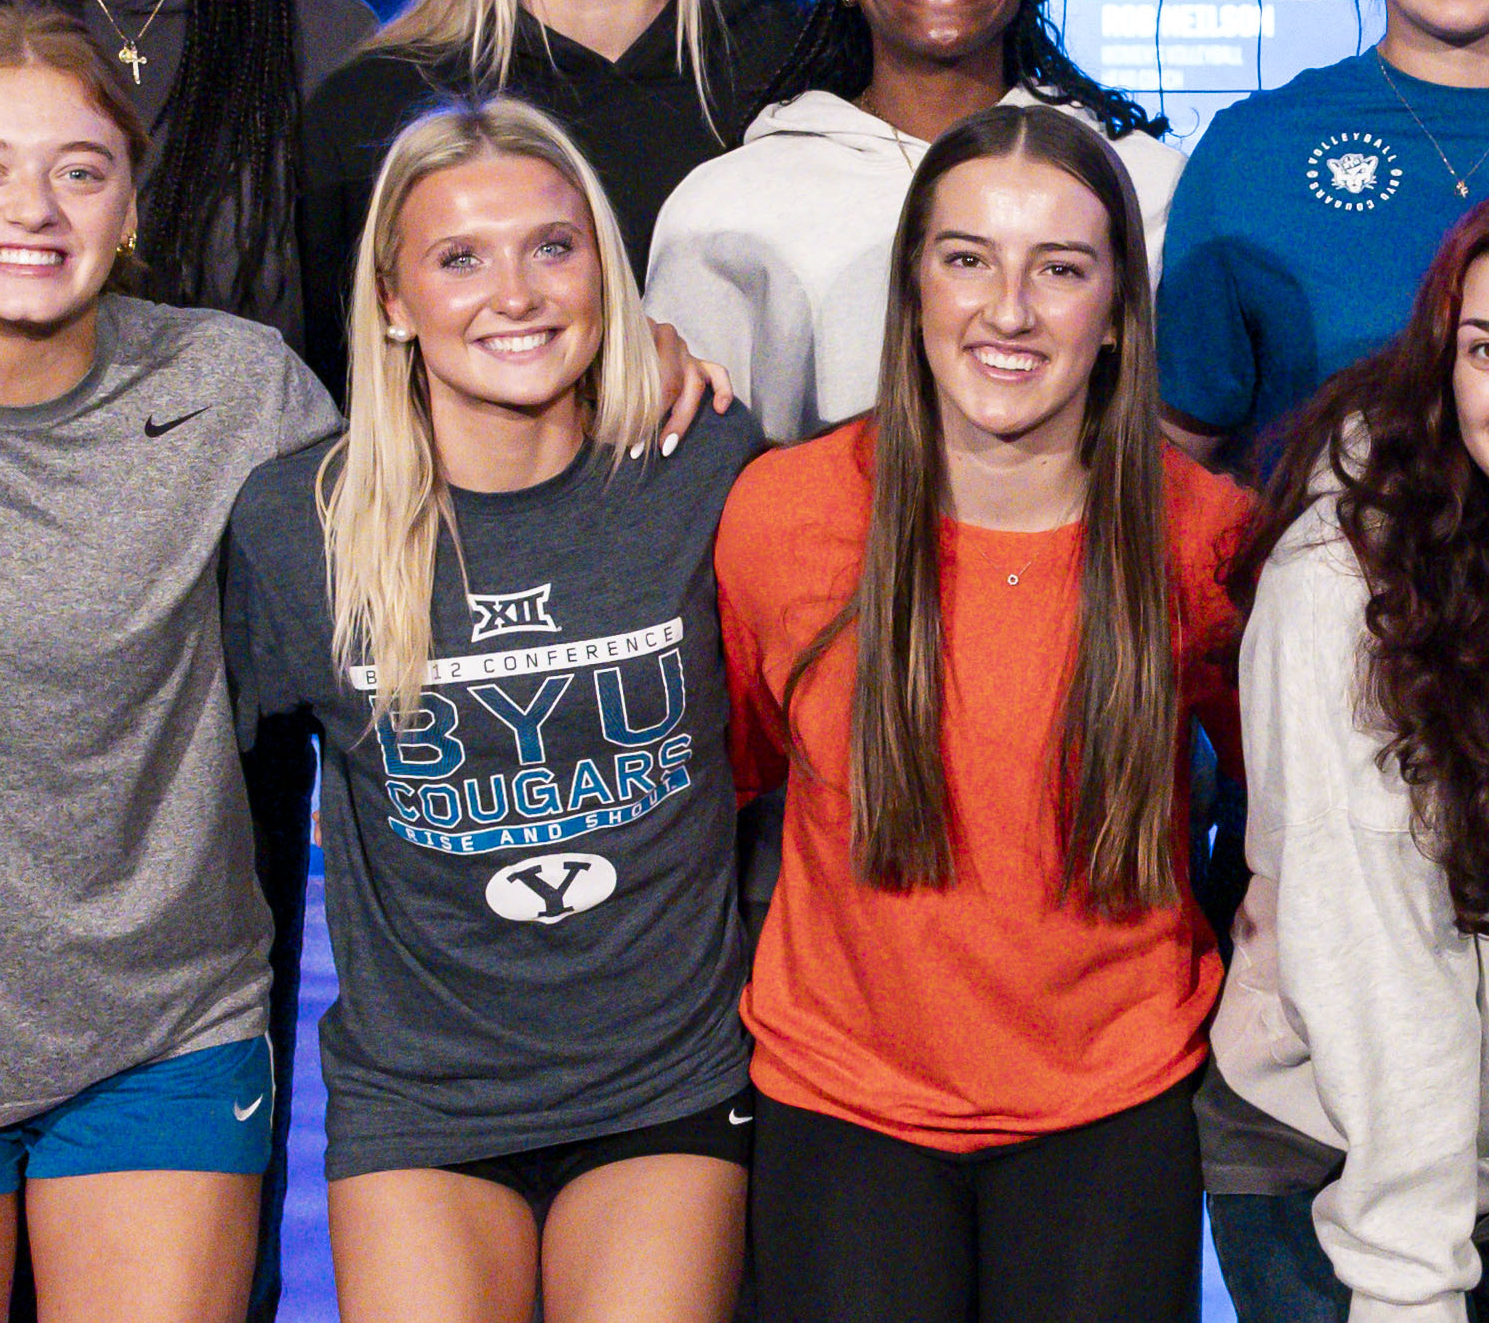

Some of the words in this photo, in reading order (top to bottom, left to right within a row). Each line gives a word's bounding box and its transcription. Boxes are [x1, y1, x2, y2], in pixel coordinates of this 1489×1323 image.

[431, 661, 462, 680] 12
[483, 625, 674, 675] CONFERENCE
[369, 647, 686, 780] BYU
[385, 733, 693, 829] COUGARS
[405, 827, 474, 852] RISE
[500, 822, 562, 844] AND
[506, 860, 592, 919] Y
